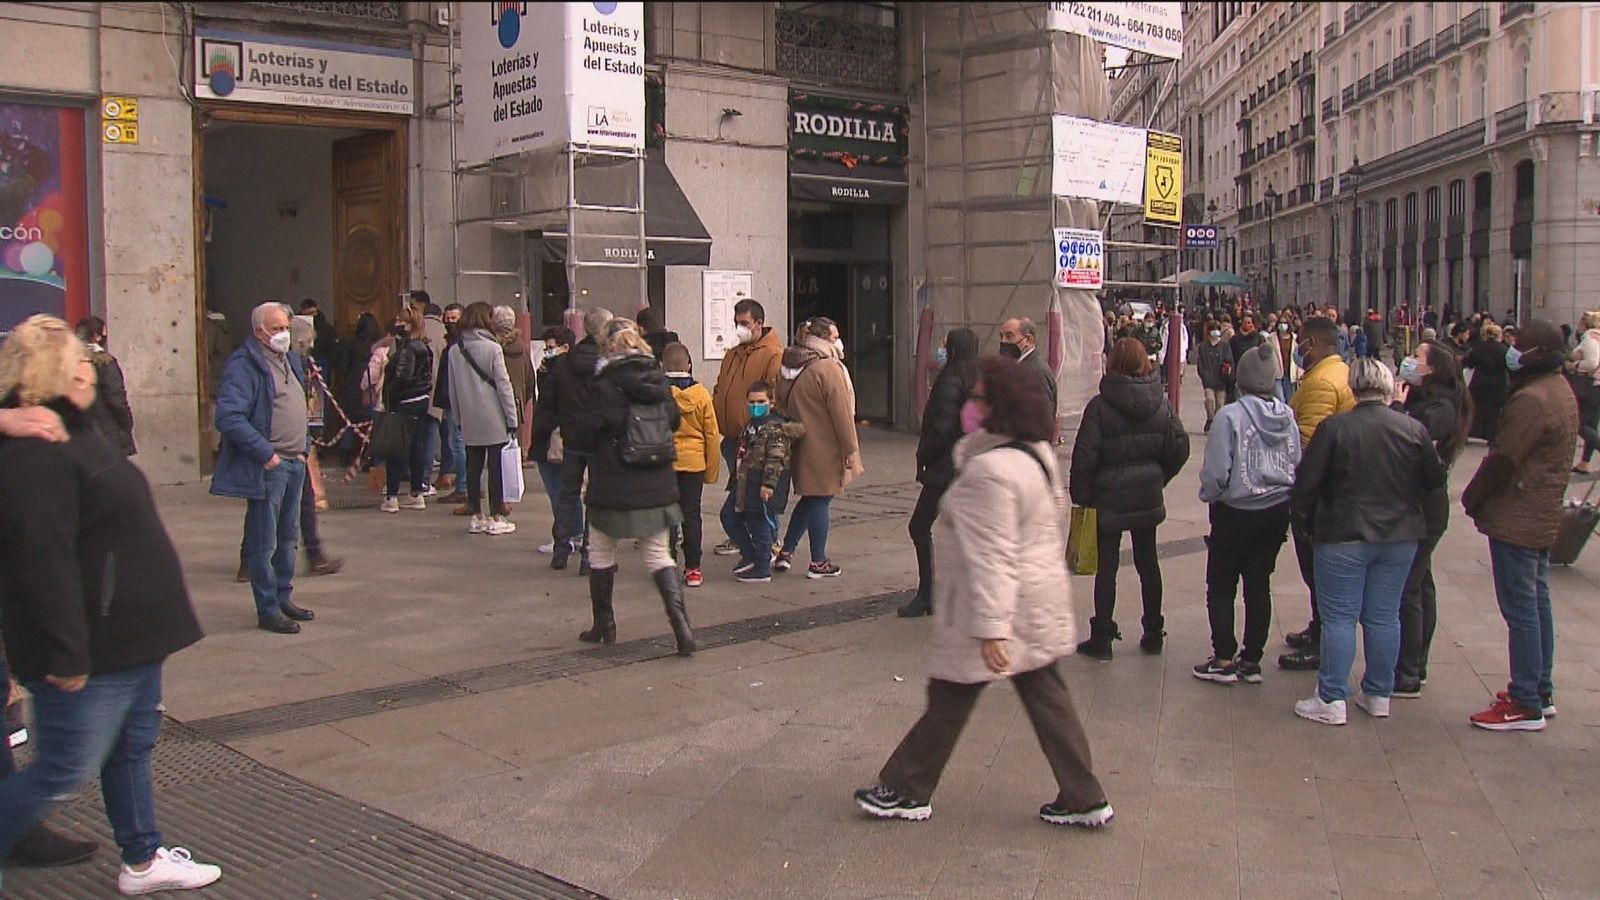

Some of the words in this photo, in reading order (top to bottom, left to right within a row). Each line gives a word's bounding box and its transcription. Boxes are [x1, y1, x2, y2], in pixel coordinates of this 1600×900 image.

[633, 29, 640, 41] y
[1087, 6, 1102, 22] 211
[1127, 18, 1144, 35] 664
[1146, 23, 1163, 39] 763
[1165, 28, 1182, 43] 059
[583, 36, 637, 56] Apuestas
[319, 59, 328, 74] y
[491, 52, 531, 77] Loterías
[533, 51, 539, 69] y
[583, 55, 601, 71] del
[604, 58, 643, 76] Estado
[249, 68, 324, 89] Apuestas
[328, 75, 352, 91] del
[356, 78, 408, 95] Estado
[493, 74, 537, 100] Apuestas
[493, 103, 508, 122] del
[510, 95, 543, 117] Estado
[794, 111, 897, 143] RODILLA
[831, 186, 870, 198] RODILLA
[604, 248, 655, 259] RODILA
